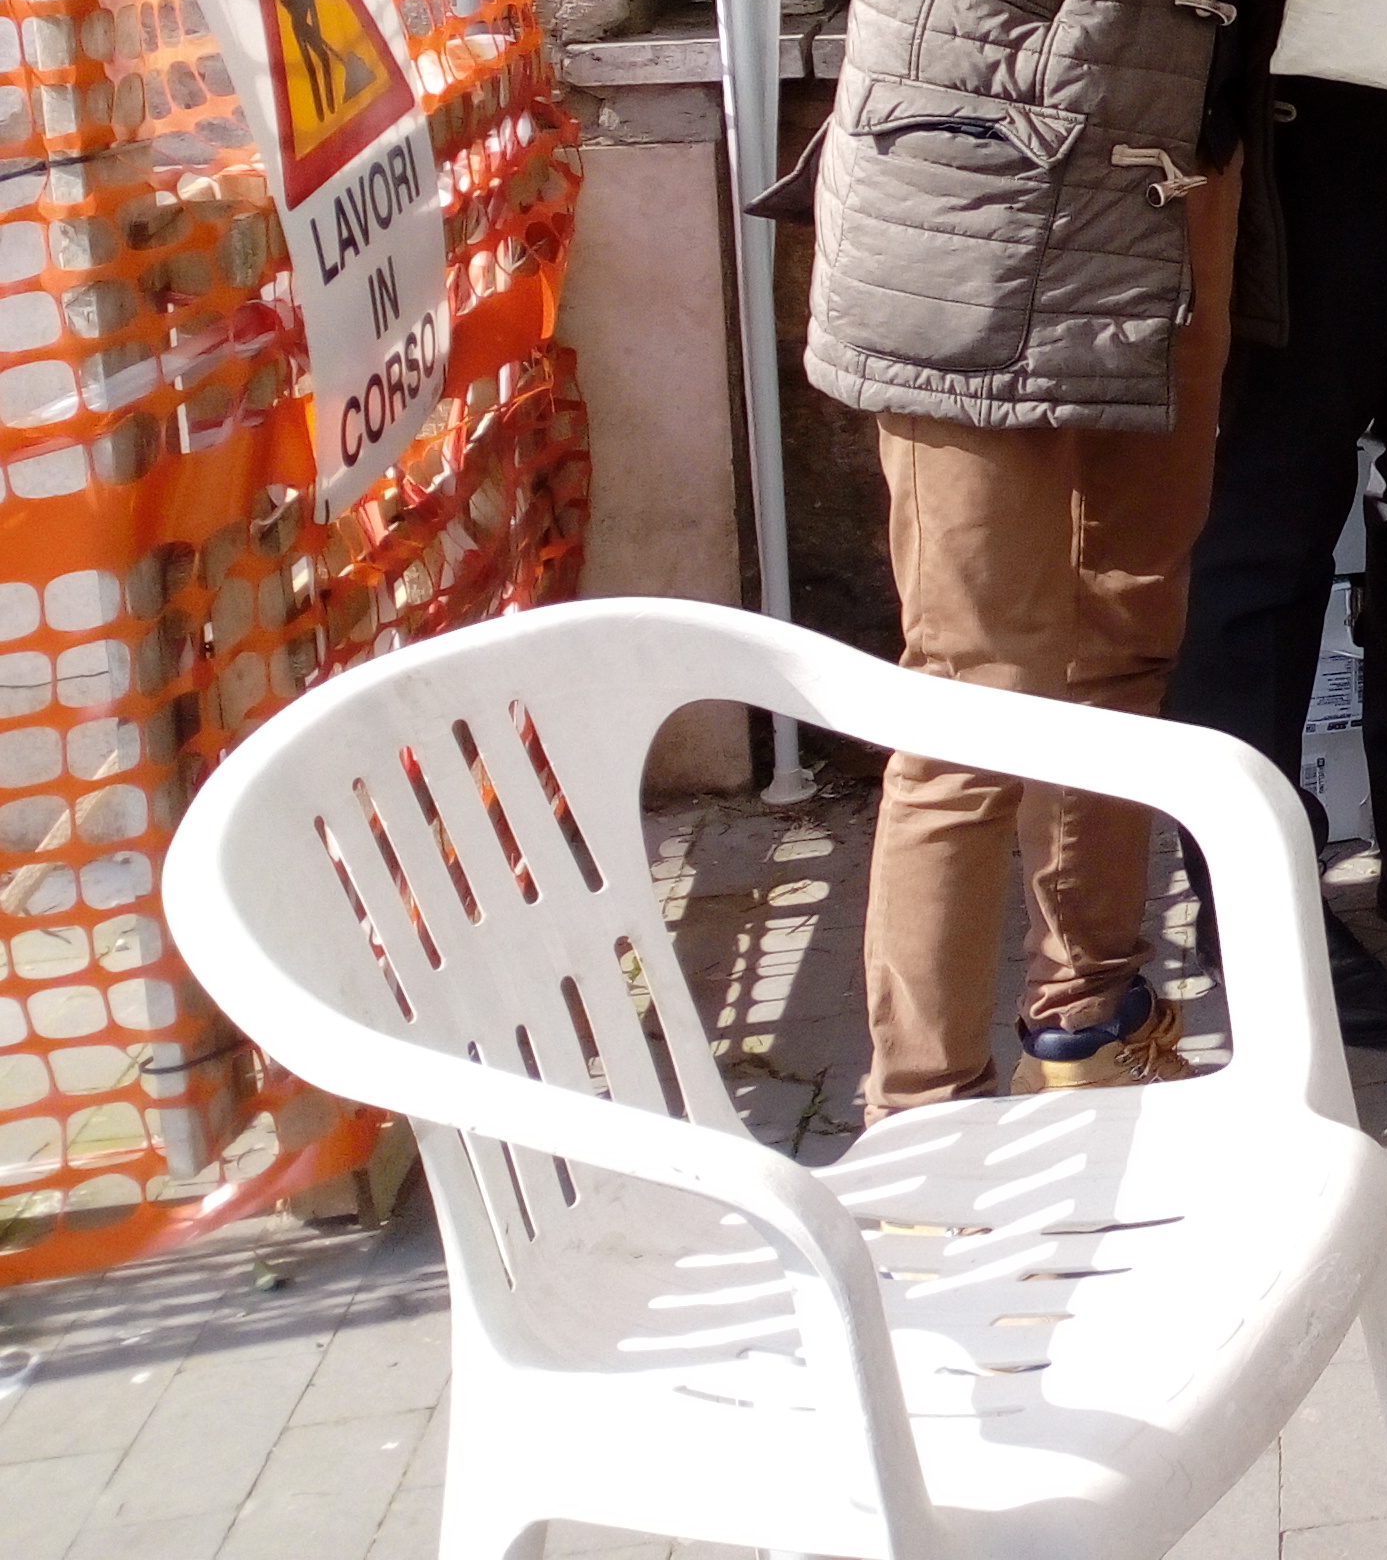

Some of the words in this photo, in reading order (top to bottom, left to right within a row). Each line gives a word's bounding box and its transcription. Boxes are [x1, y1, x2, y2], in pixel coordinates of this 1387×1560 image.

[310, 135, 421, 287] LAVORI
[367, 255, 401, 341] IN
[340, 311, 437, 468] CORSO
